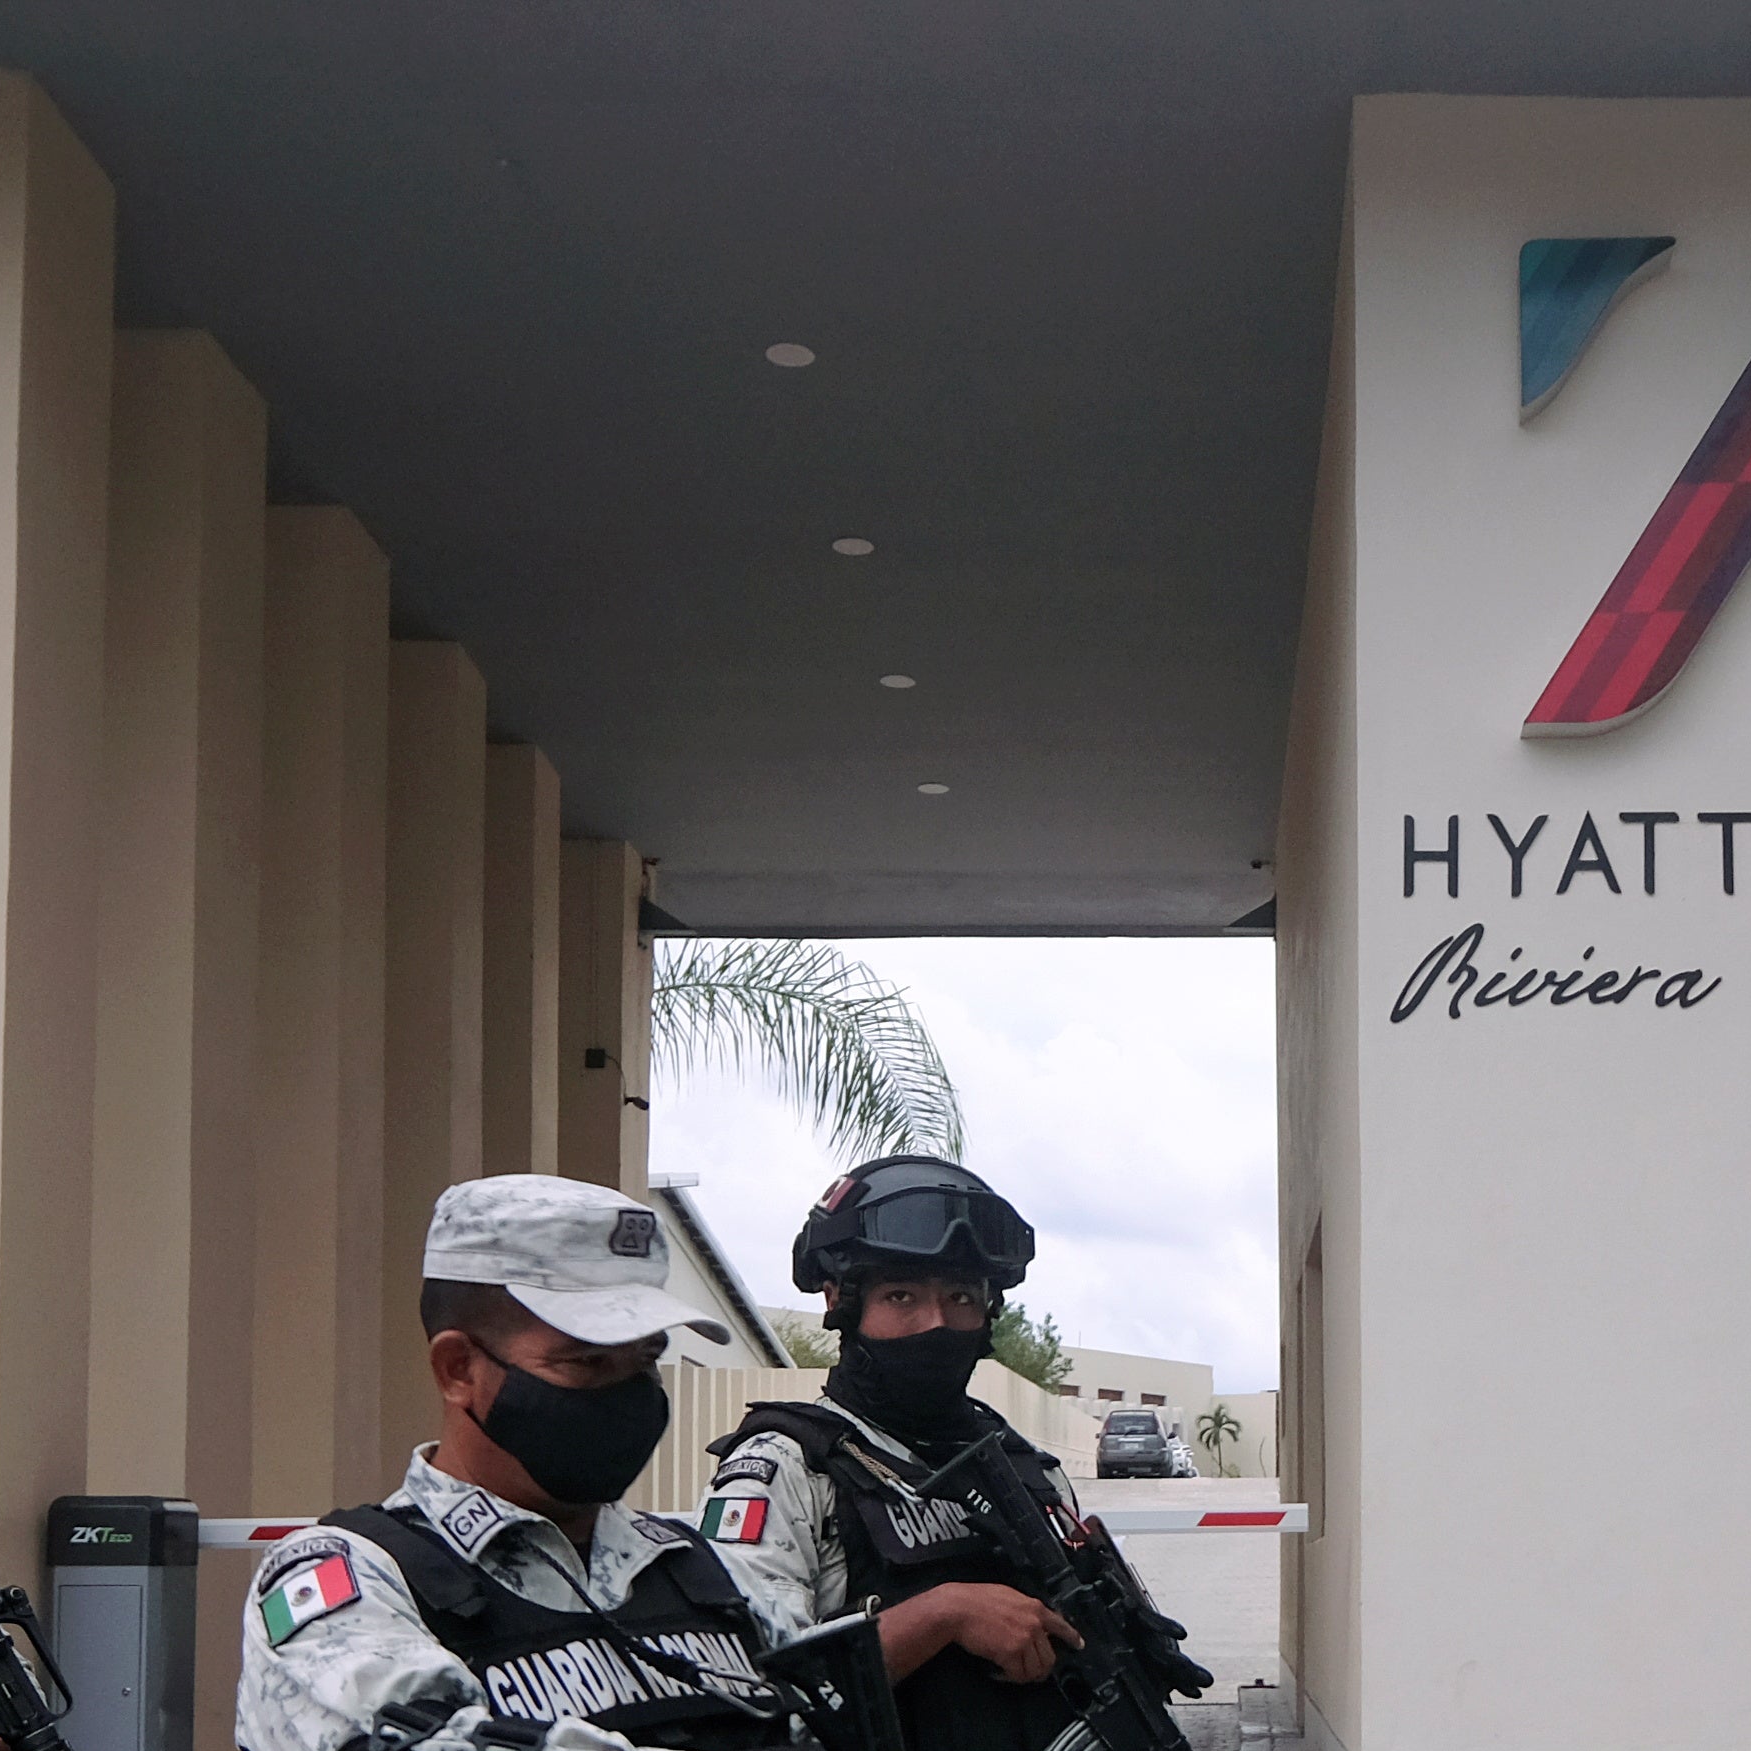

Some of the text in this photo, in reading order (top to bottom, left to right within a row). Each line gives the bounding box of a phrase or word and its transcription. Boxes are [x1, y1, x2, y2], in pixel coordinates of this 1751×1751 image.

[1389, 922, 1723, 1024] Riviera
[454, 1500, 489, 1536] GN
[885, 1497, 970, 1549] GUARD
[485, 1637, 651, 1723] GUARDIA
